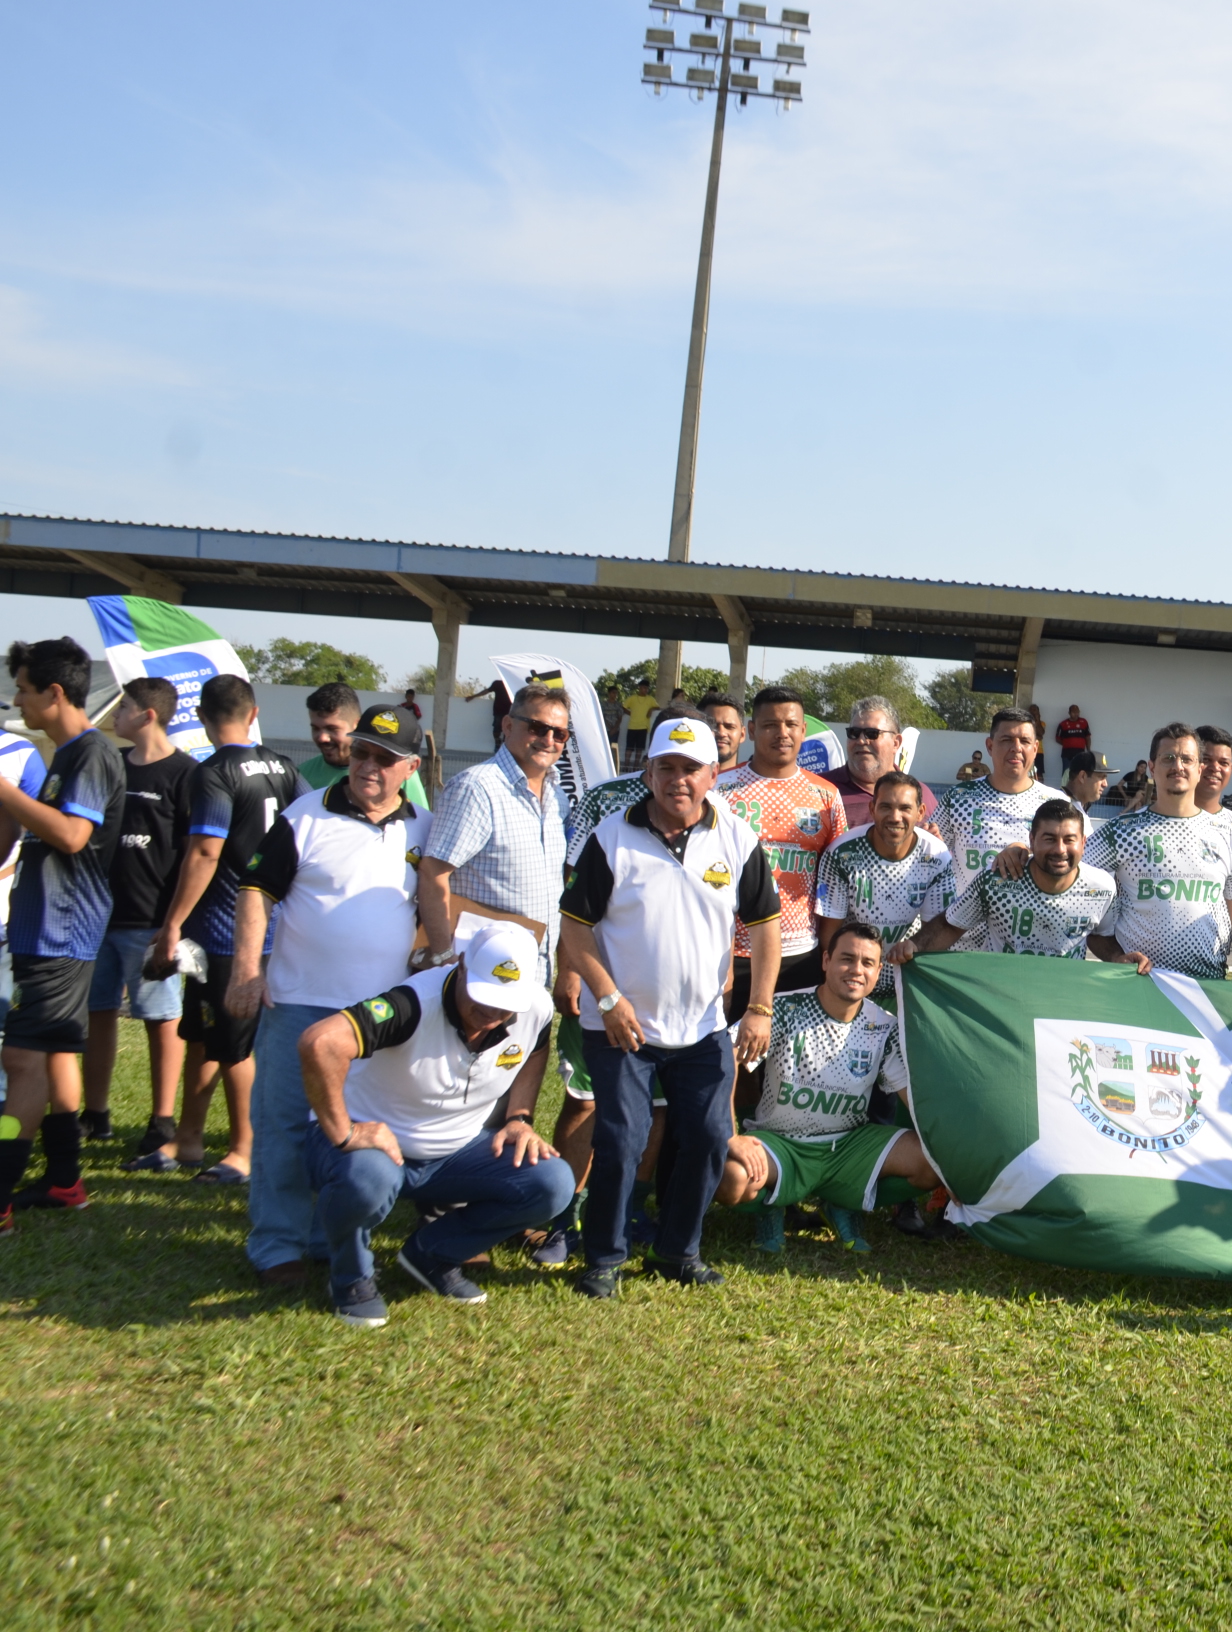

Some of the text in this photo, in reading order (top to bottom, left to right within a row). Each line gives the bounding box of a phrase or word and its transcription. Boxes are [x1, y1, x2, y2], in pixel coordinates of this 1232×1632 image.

[162, 667, 213, 683] OVERNO DE
[172, 680, 202, 694] ato
[797, 749, 816, 759] OVERNO
[802, 761, 826, 772] rosso
[972, 808, 983, 836] 5
[1143, 834, 1164, 864] 15
[1137, 878, 1222, 903] BONITO
[1011, 906, 1034, 937] 18
[776, 1081, 867, 1115] BONITO
[1081, 1105, 1100, 1123] 2-10
[1101, 1124, 1186, 1150] BONITO
